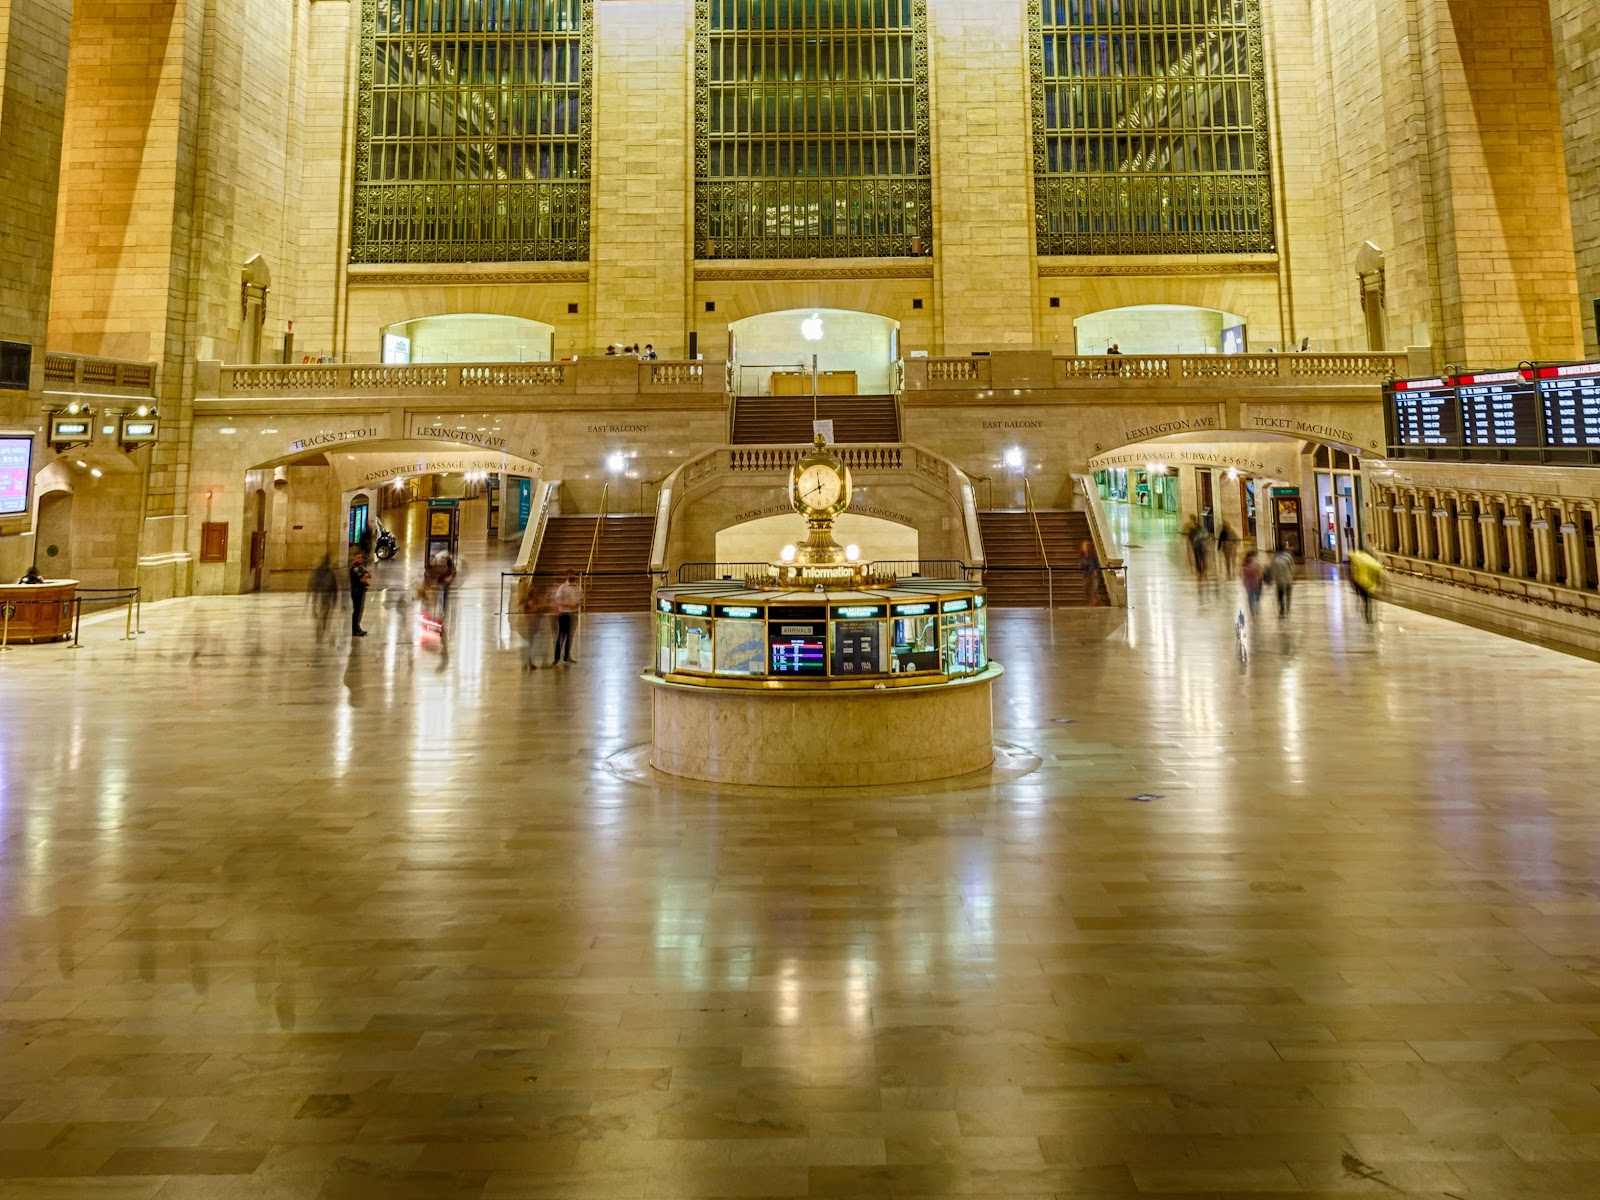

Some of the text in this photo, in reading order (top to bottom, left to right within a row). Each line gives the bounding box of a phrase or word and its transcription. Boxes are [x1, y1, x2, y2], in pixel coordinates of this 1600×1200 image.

[587, 425, 649, 433] EAST BALCONY
[982, 420, 1043, 429] EAST BALCONY
[1125, 417, 1214, 440] LEXINGTON AVE
[1254, 417, 1353, 441] TICKET MACHINES
[293, 433, 335, 449] TRACKS
[350, 429, 366, 438] TO
[417, 427, 506, 448] LEXINGTON AVE
[1100, 454, 1135, 466] STREET
[1136, 452, 1176, 461] PASSAGE
[1180, 452, 1220, 462] SUBWAY
[365, 469, 389, 481] 42ND
[390, 463, 423, 475] STREET
[426, 461, 464, 470] PASSAGE
[472, 460, 509, 470] SUBWAY
[735, 509, 763, 521] TRACKS
[868, 506, 913, 524] CONCOURSE
[802, 566, 853, 578] Information
